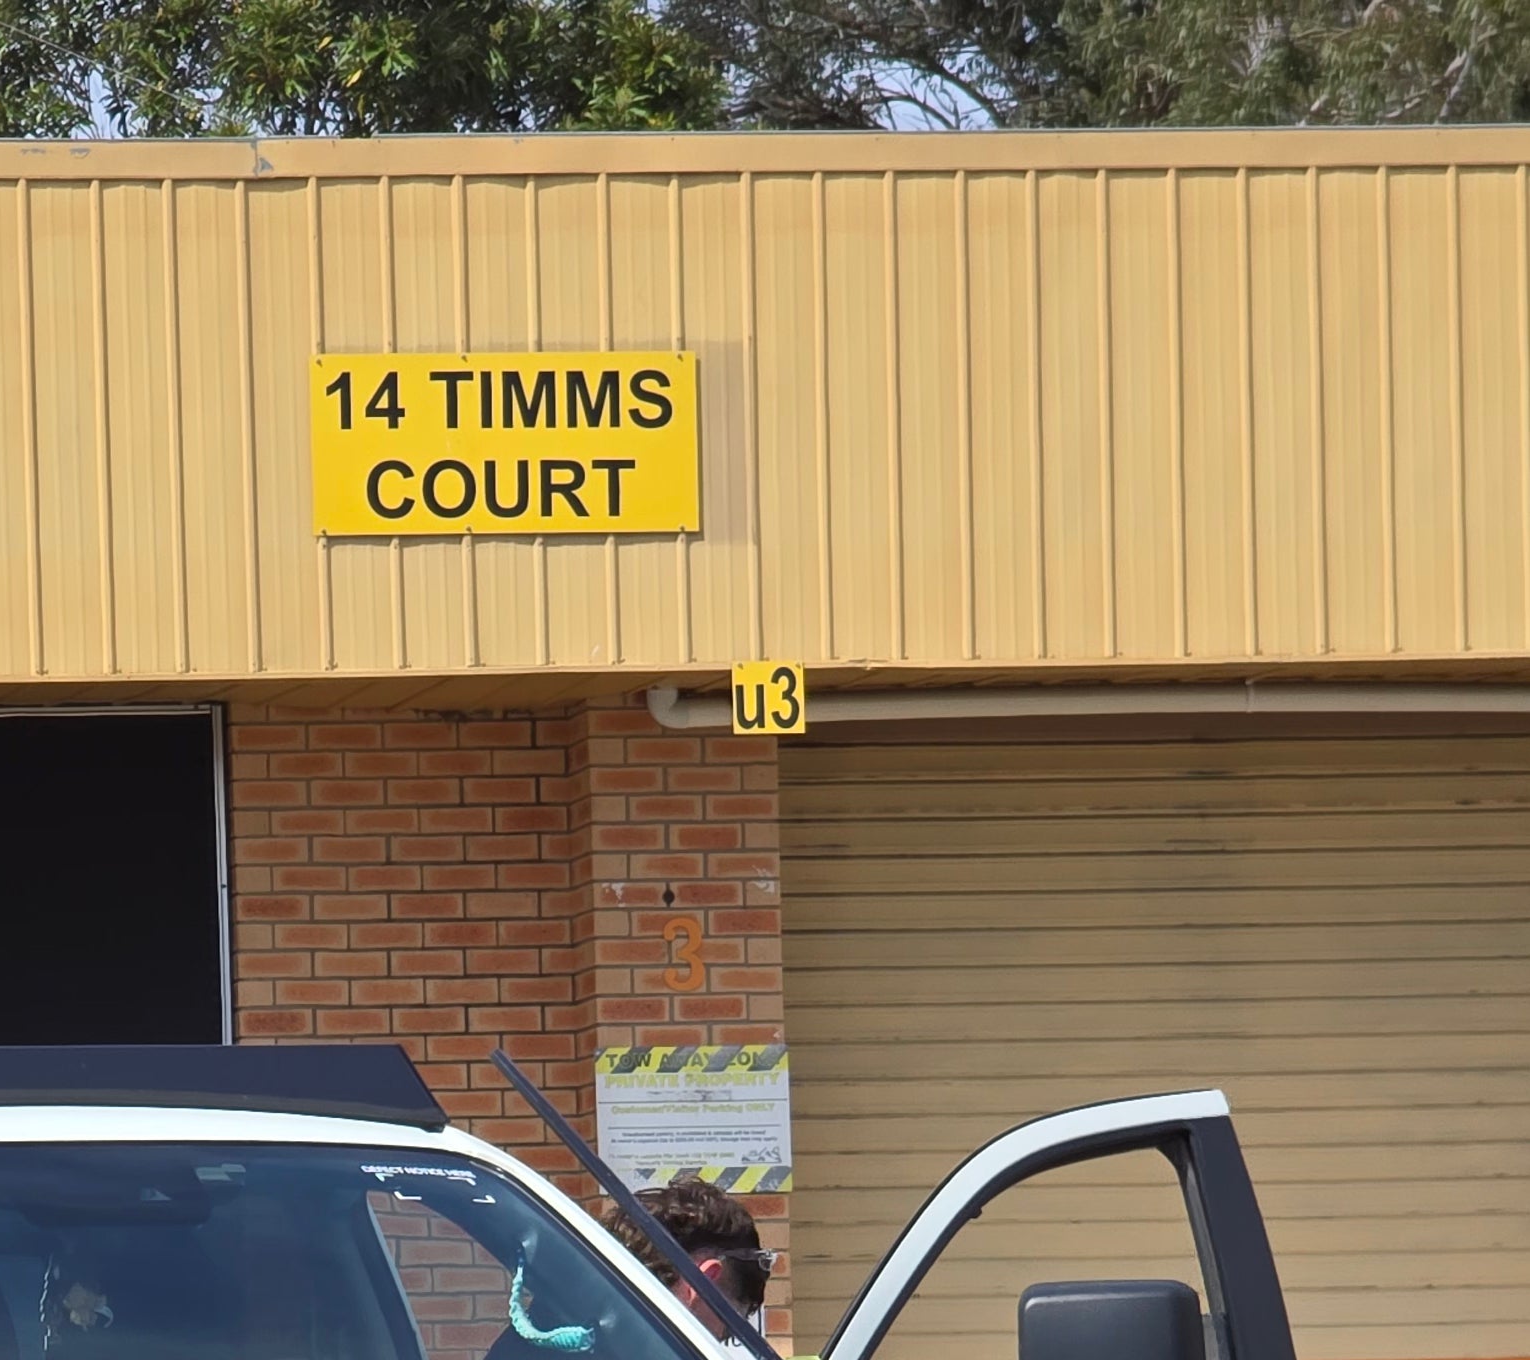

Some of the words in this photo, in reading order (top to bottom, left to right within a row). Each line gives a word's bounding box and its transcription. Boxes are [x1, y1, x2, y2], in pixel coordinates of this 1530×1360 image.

[325, 371, 406, 430] 14
[429, 369, 673, 430] TIMMS
[366, 458, 636, 518] COURT
[735, 666, 800, 730] u3
[663, 917, 706, 991] 3
[605, 1074, 679, 1089] PRIVATE
[685, 1073, 780, 1087] PROPERTY
[606, 1053, 651, 1068] TOW
